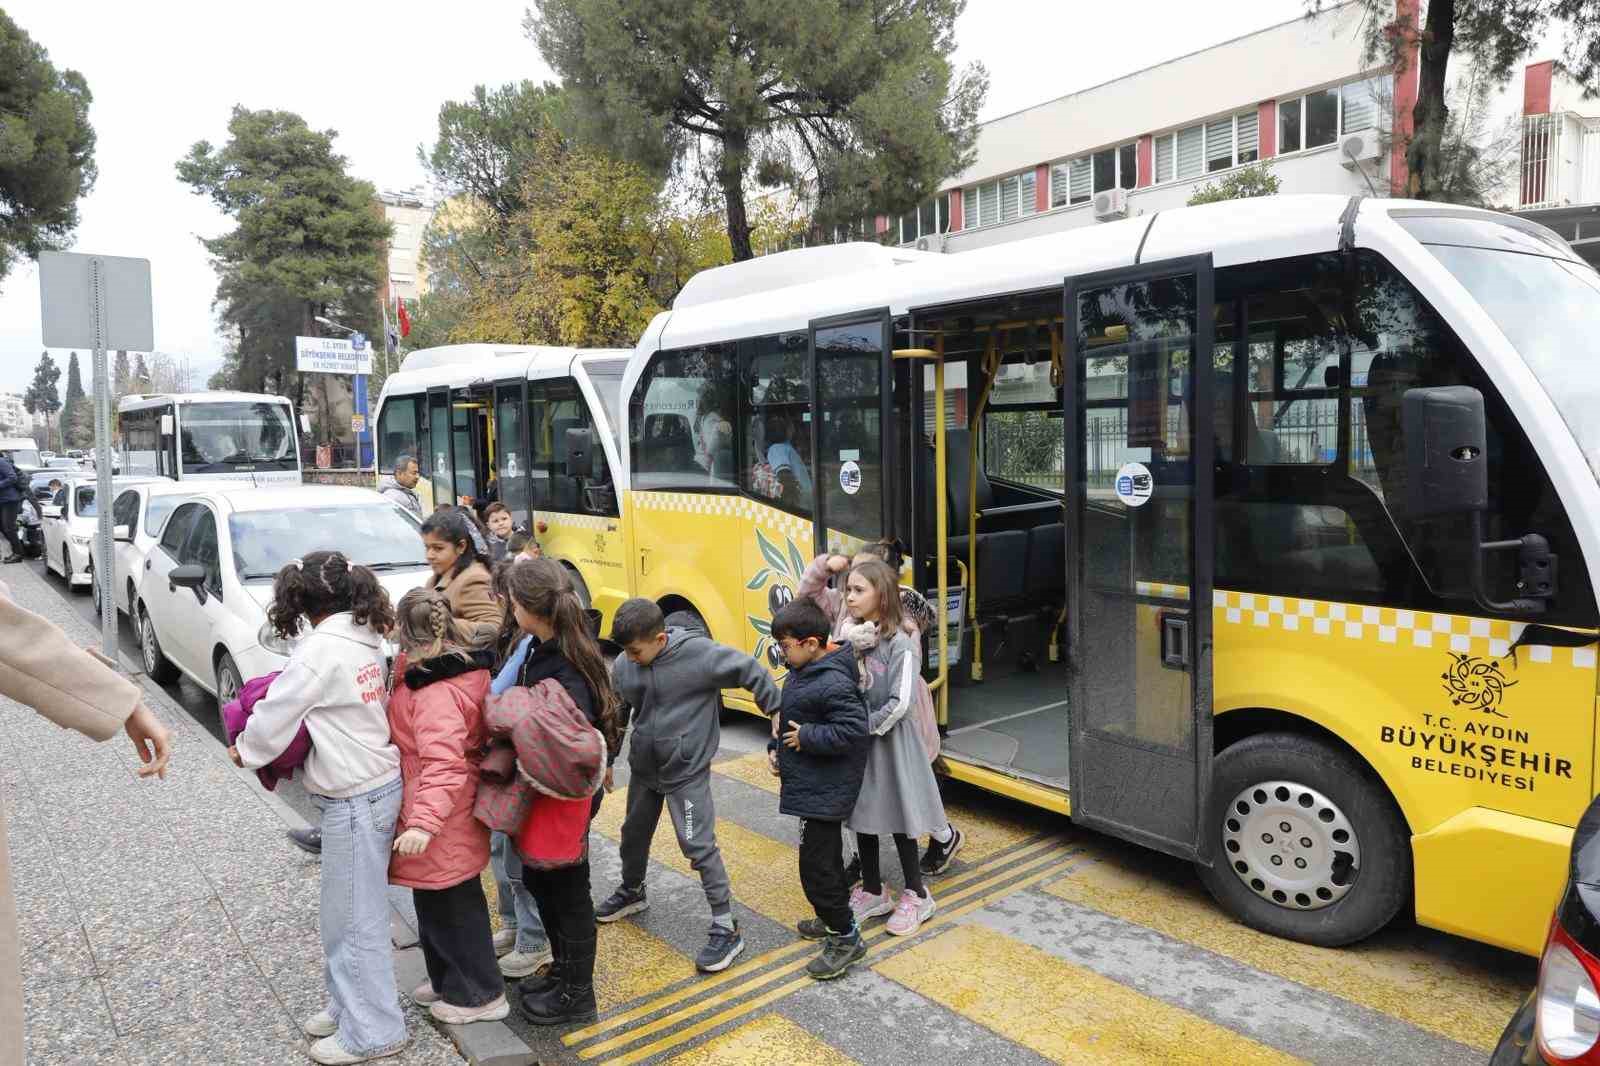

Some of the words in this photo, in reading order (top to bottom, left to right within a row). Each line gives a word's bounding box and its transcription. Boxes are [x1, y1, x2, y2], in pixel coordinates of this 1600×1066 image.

[1422, 713, 1457, 731] T.C.
[1464, 721, 1529, 744] AYDIN
[1380, 725, 1573, 779] BÜYÜKŞEHİR
